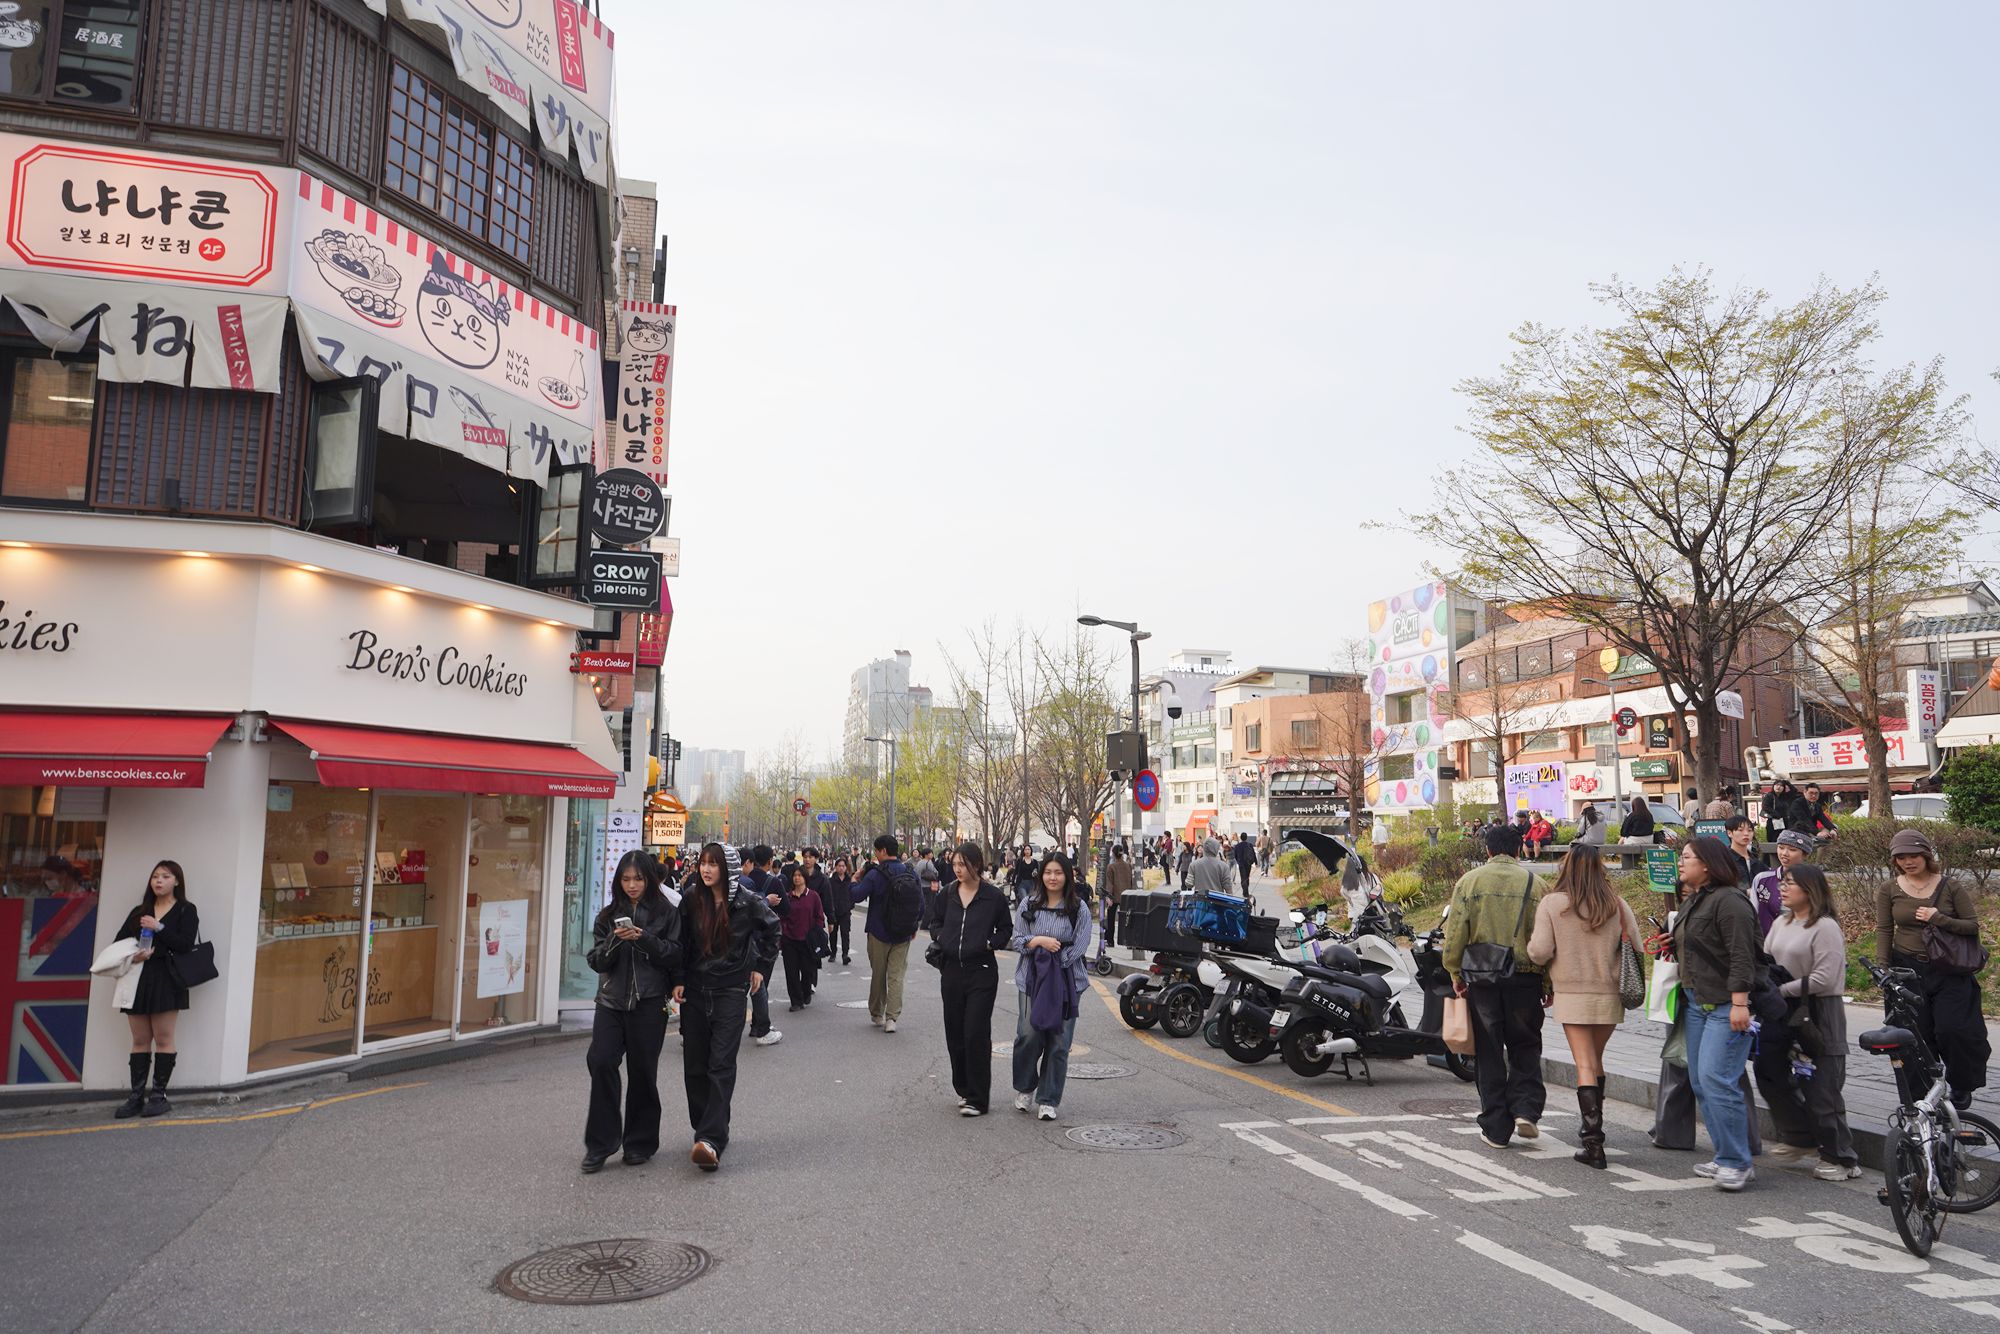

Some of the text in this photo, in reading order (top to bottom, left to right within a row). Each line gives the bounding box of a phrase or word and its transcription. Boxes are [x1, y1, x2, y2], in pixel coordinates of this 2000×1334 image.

[75, 27, 124, 49] 居酒屋
[528, 20, 550, 45] NYA
[560, 6, 581, 76] うまい
[527, 32, 549, 55] NYA
[526, 42, 549, 66] KUN
[61, 179, 231, 231] 냐냐쿤
[59, 227, 191, 254] 일본요리 전문점
[203, 243, 223, 256] 2F
[507, 349, 530, 366] NYA
[506, 361, 529, 378] NYA
[505, 373, 529, 389] KUN
[622, 387, 653, 463] 냐냐쿤
[464, 426, 505, 444] おいしい
[596, 480, 631, 498] 수상한
[593, 498, 658, 532] 사진관
[593, 564, 650, 580] CROW
[594, 584, 647, 596] piercing
[346, 630, 528, 697] Ben's Cookies
[584, 657, 630, 668] Ben's Cookies
[1921, 684, 1936, 727] 꼼장어
[1788, 742, 1820, 756] 대왕
[42, 767, 186, 781] www.benscookies.co.kr
[548, 783, 610, 793] www.benscookies.co.kr
[654, 820, 684, 829] 아메리카노
[341, 968, 381, 989] Bn's
[1312, 994, 1350, 1019] STORM
